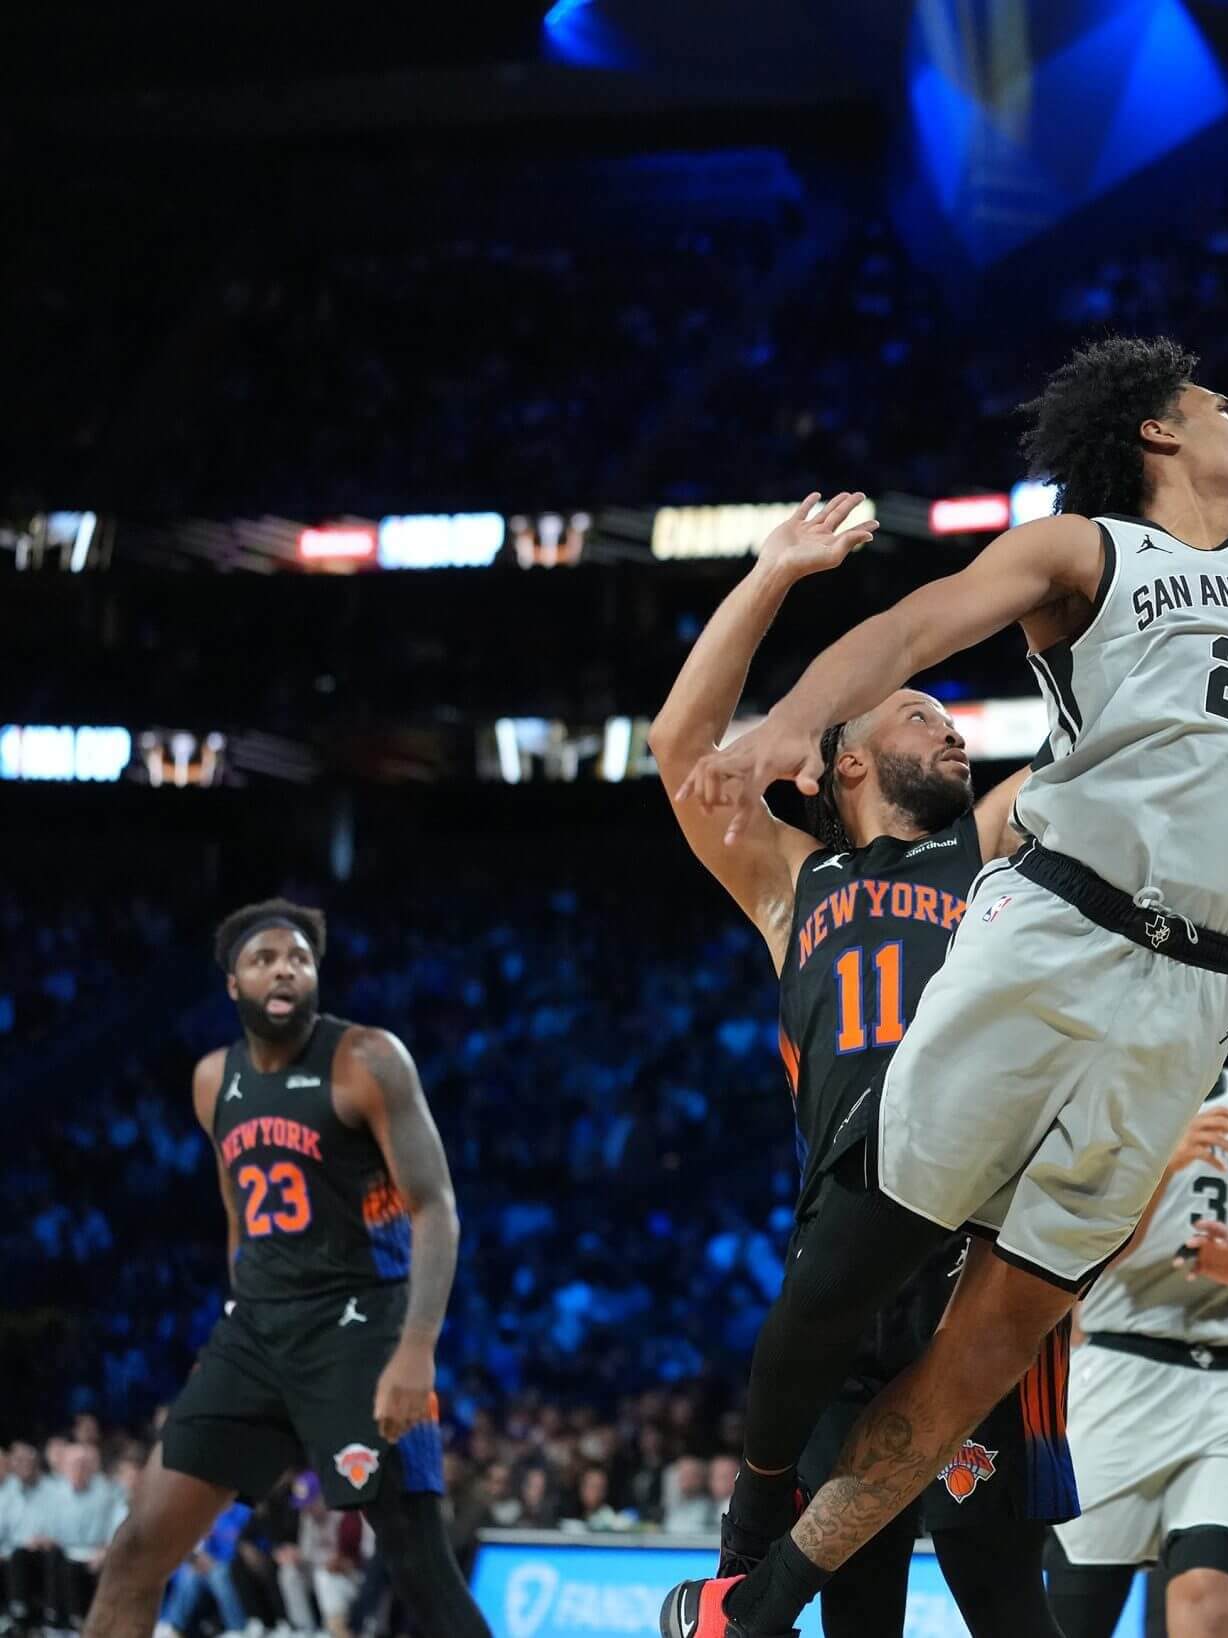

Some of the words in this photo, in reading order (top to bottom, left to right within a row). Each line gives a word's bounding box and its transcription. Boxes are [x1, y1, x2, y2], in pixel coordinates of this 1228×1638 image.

[1132, 574, 1194, 632] SAN
[926, 837, 957, 849] dhabi
[799, 878, 860, 970] NEW
[863, 879, 967, 932] YORK
[833, 939, 907, 1056] 11
[221, 1118, 259, 1169] NEW
[259, 1115, 324, 1163] YORK
[237, 1160, 312, 1238] 23
[1189, 1175, 1228, 1238] 3
